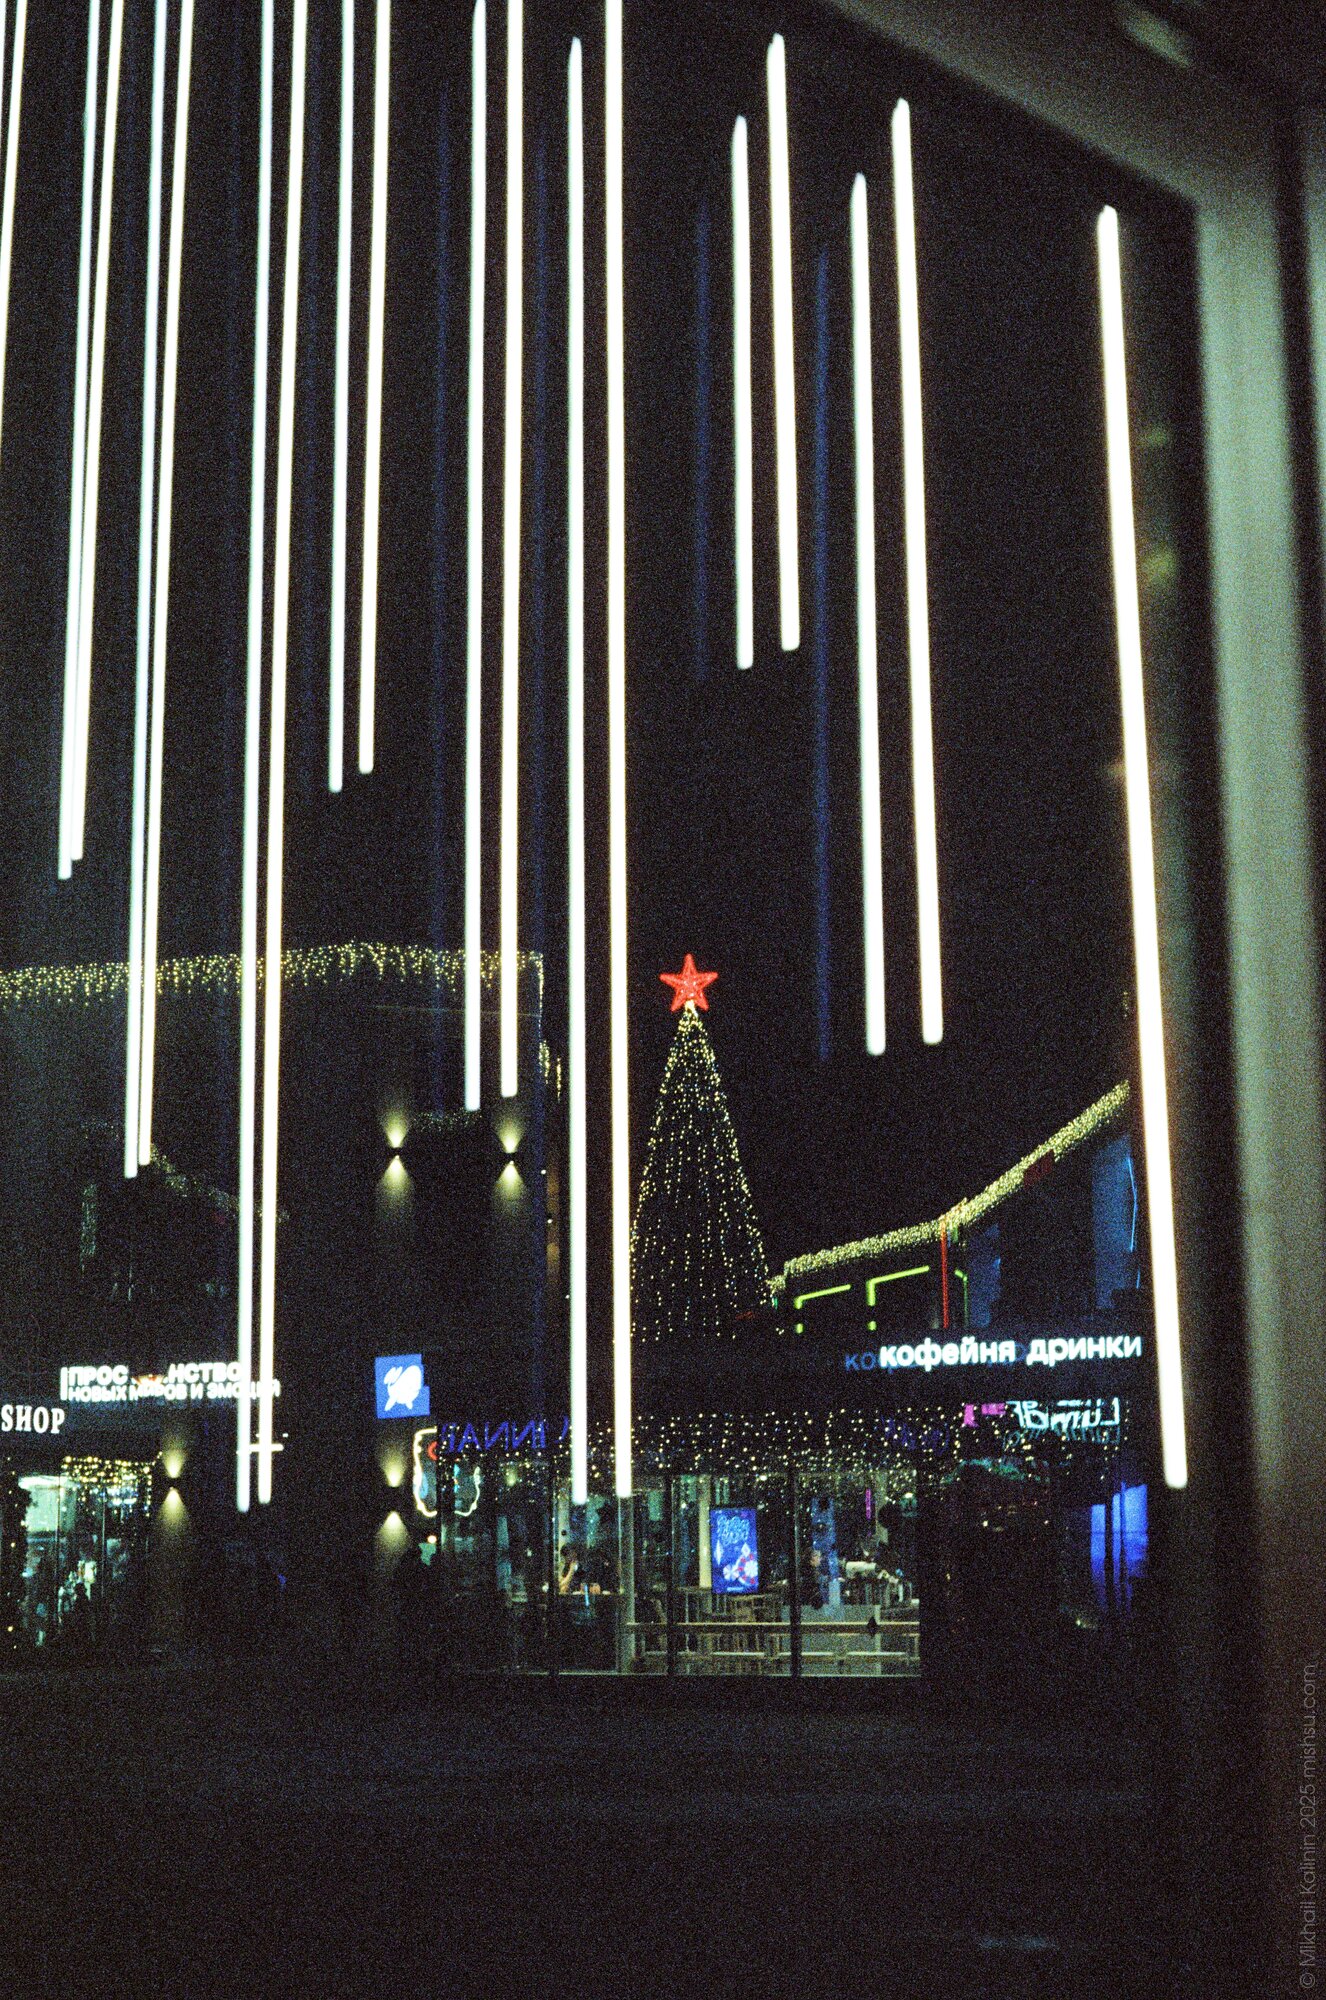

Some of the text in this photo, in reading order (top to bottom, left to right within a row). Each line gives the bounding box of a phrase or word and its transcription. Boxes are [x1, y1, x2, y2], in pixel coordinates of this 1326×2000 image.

[880, 1336, 1016, 1372] кофейня
[1026, 1336, 1142, 1366] дринки
[68, 1363, 243, 1385] ПРОСНСТВО
[69, 1385, 127, 1402] НОВЫХ
[190, 1383, 204, 1399] И
[1, 1404, 65, 1434] SHOP
